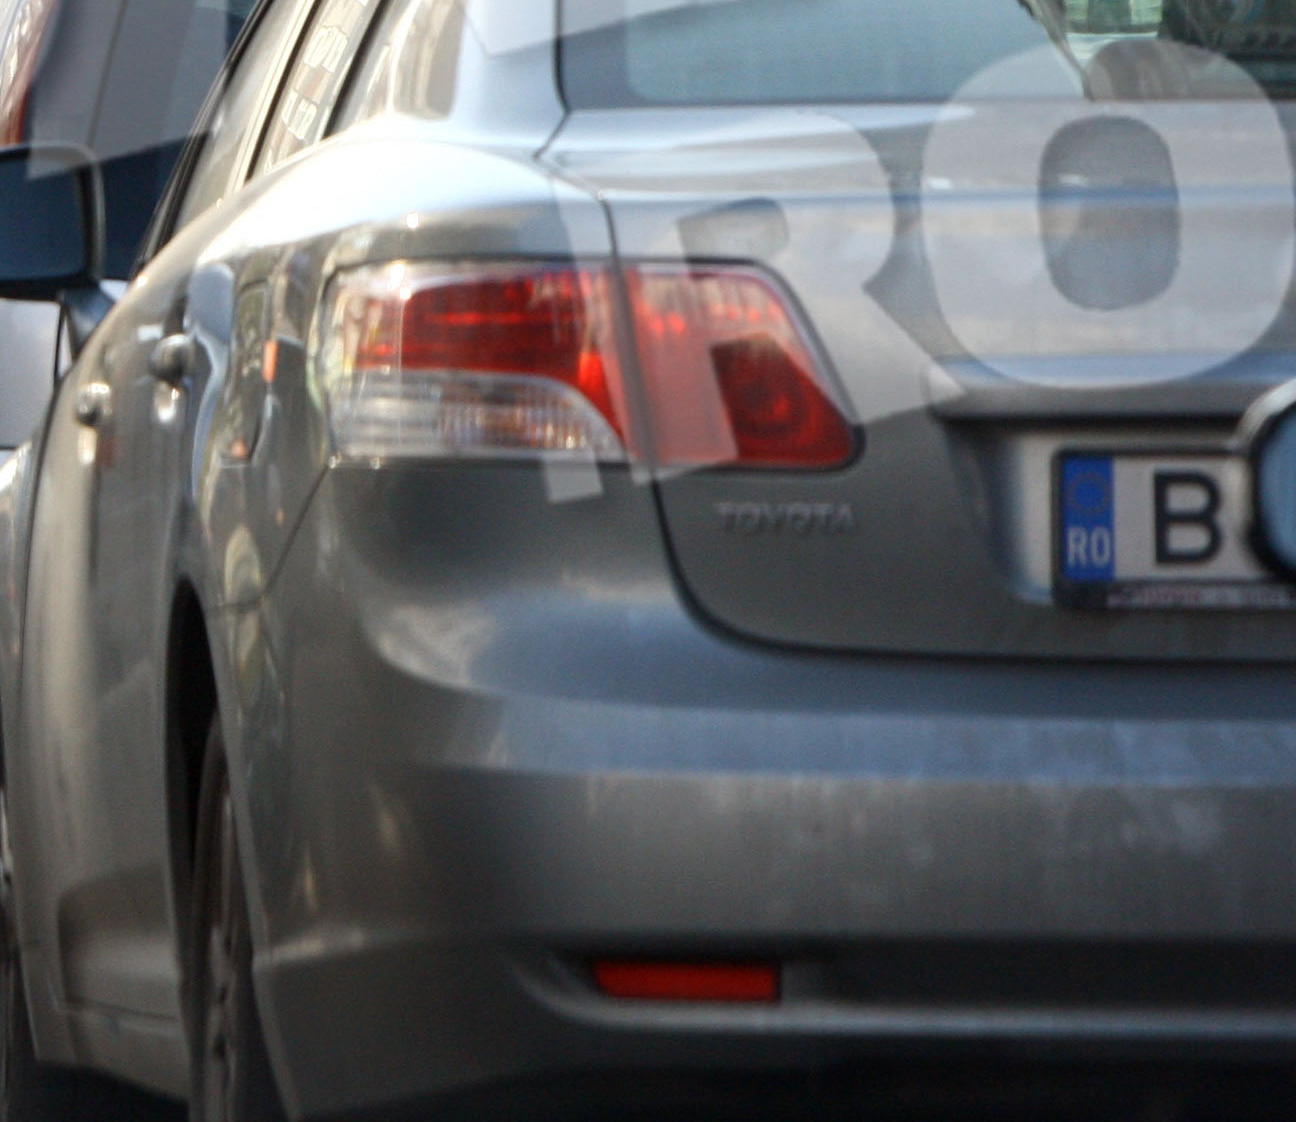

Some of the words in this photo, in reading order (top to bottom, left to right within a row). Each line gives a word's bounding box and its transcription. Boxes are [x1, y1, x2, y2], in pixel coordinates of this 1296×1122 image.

[713, 501, 855, 534] TOYOTA
[1154, 468, 1223, 564] B
[1066, 527, 1111, 568] RO
